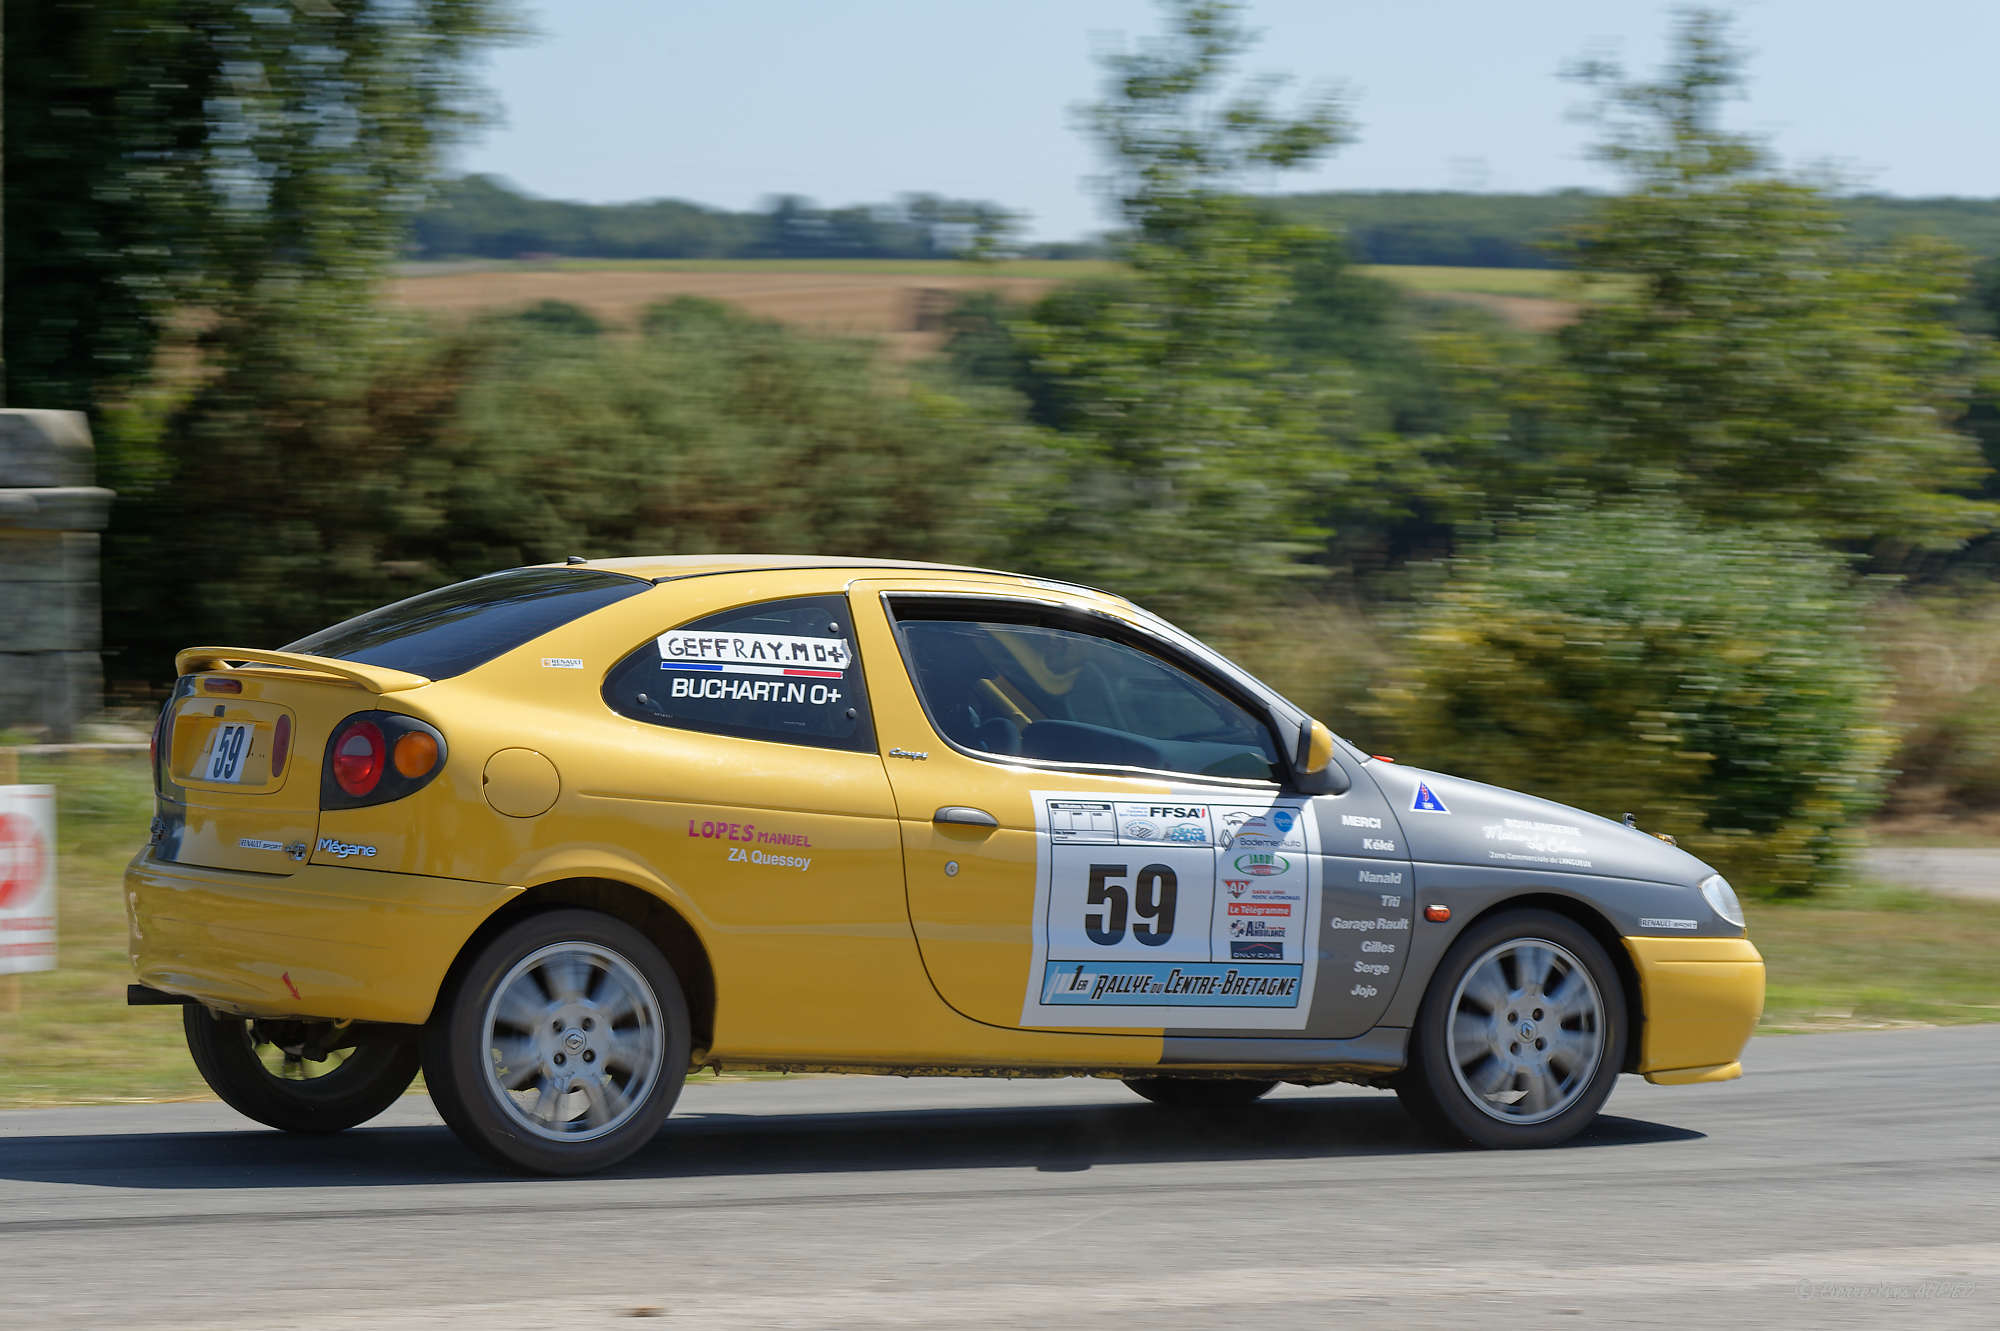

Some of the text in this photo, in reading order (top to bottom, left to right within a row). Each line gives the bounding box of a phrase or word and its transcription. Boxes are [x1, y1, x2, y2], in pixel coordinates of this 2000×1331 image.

[213, 726, 245, 779] 59
[1150, 807, 1200, 818] FFSA
[1341, 814, 1382, 830] MERCI
[688, 819, 812, 848] LOPES MANUEL
[318, 838, 377, 858] Mégane
[728, 848, 812, 871] ZA Quessoy
[1085, 863, 1178, 947] 59
[1331, 917, 1376, 932] Garage
[1361, 940, 1395, 953] Gilles
[1353, 960, 1390, 976] Serge
[1091, 974, 1153, 1000] RALLYE
[1351, 984, 1377, 998] Jojo
